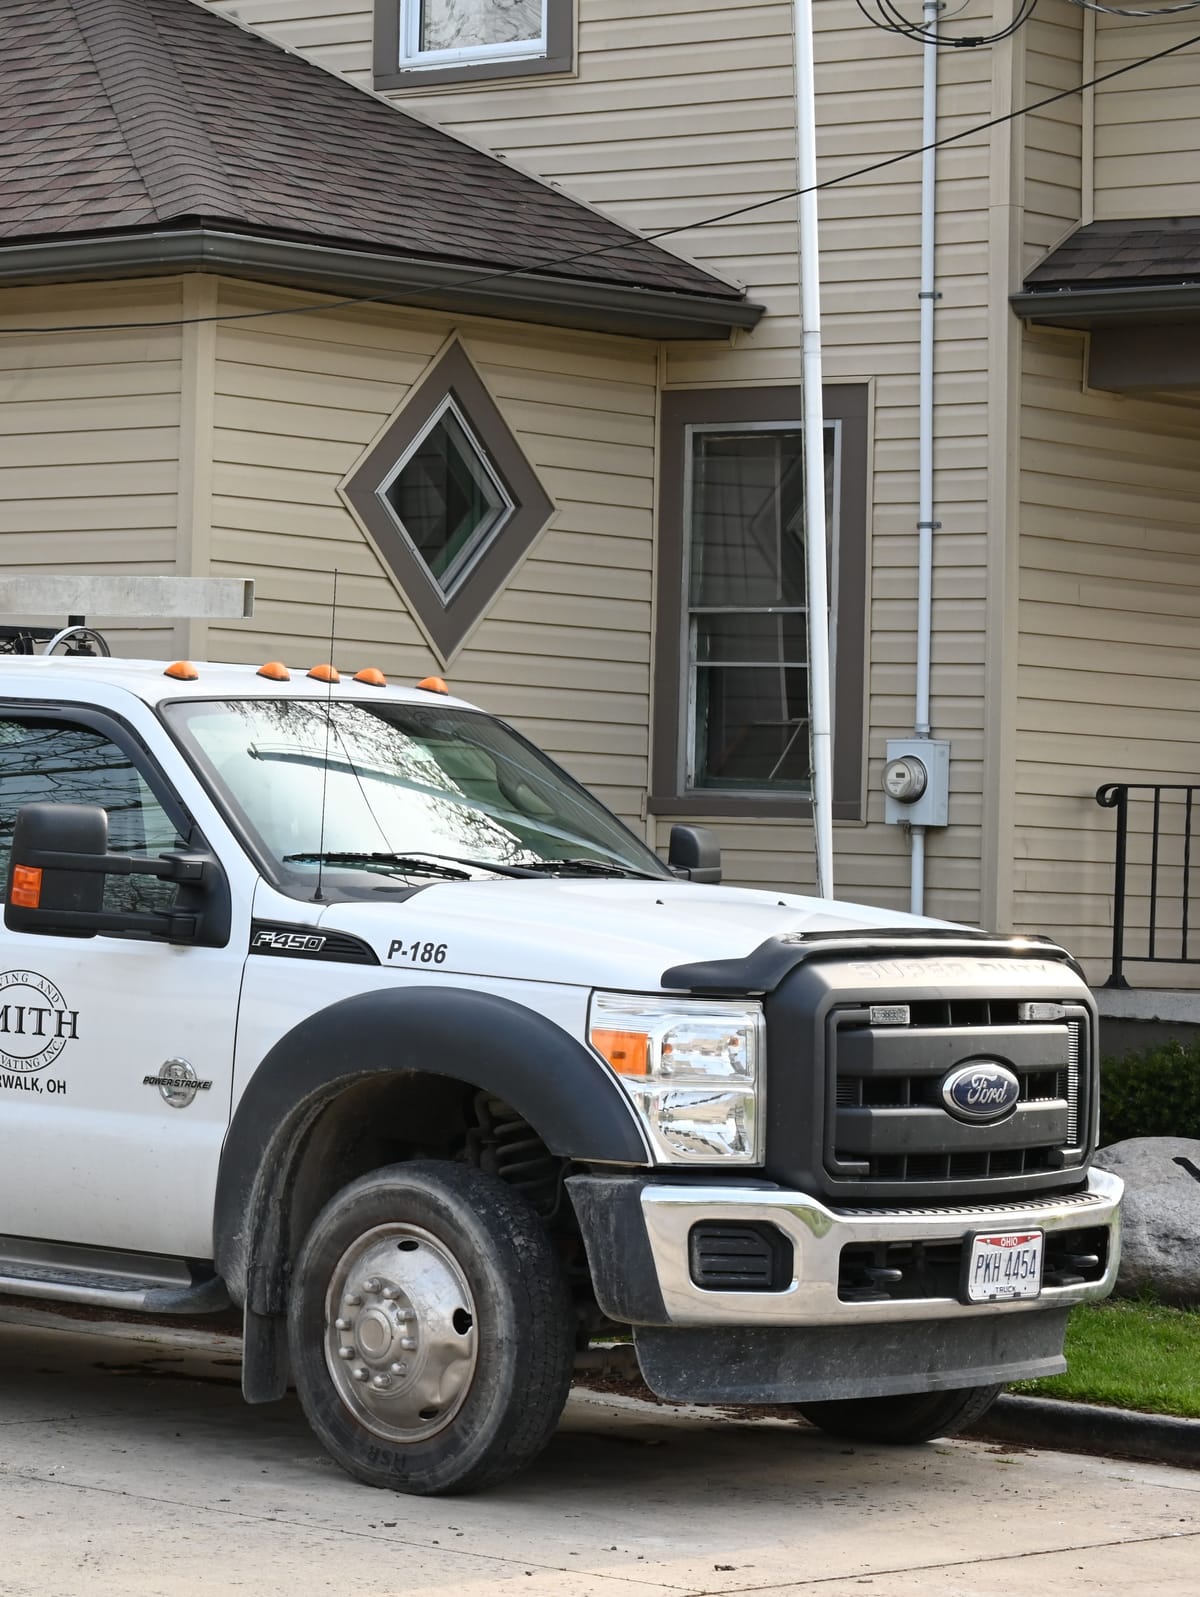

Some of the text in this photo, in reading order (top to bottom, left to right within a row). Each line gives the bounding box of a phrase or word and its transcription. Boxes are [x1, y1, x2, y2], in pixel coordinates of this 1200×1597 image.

[251, 931, 326, 952] F-450
[387, 939, 448, 964] P-186
[37, 979, 60, 1003] AND
[42, 1040, 63, 1062] INC.
[46, 1079, 66, 1094] OH
[967, 1074, 1008, 1104] Ford
[1000, 1237, 1018, 1247] OHIO
[974, 1249, 1037, 1284] PKH 4454
